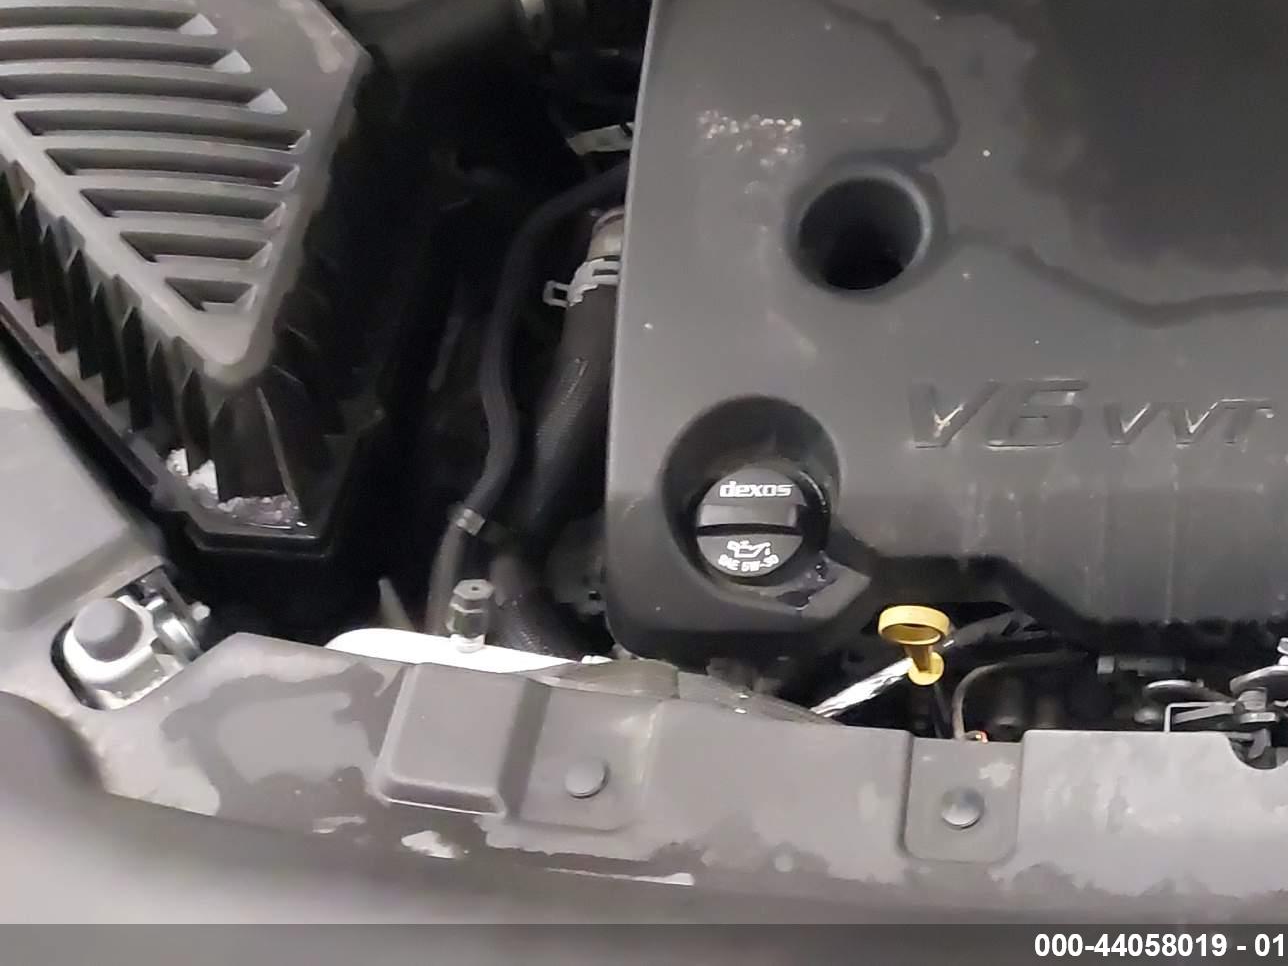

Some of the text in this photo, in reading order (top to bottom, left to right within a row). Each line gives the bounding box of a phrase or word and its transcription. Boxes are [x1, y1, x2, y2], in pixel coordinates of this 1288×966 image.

[908, 379, 1273, 449] V6 VVT
[720, 480, 793, 498] dexos
